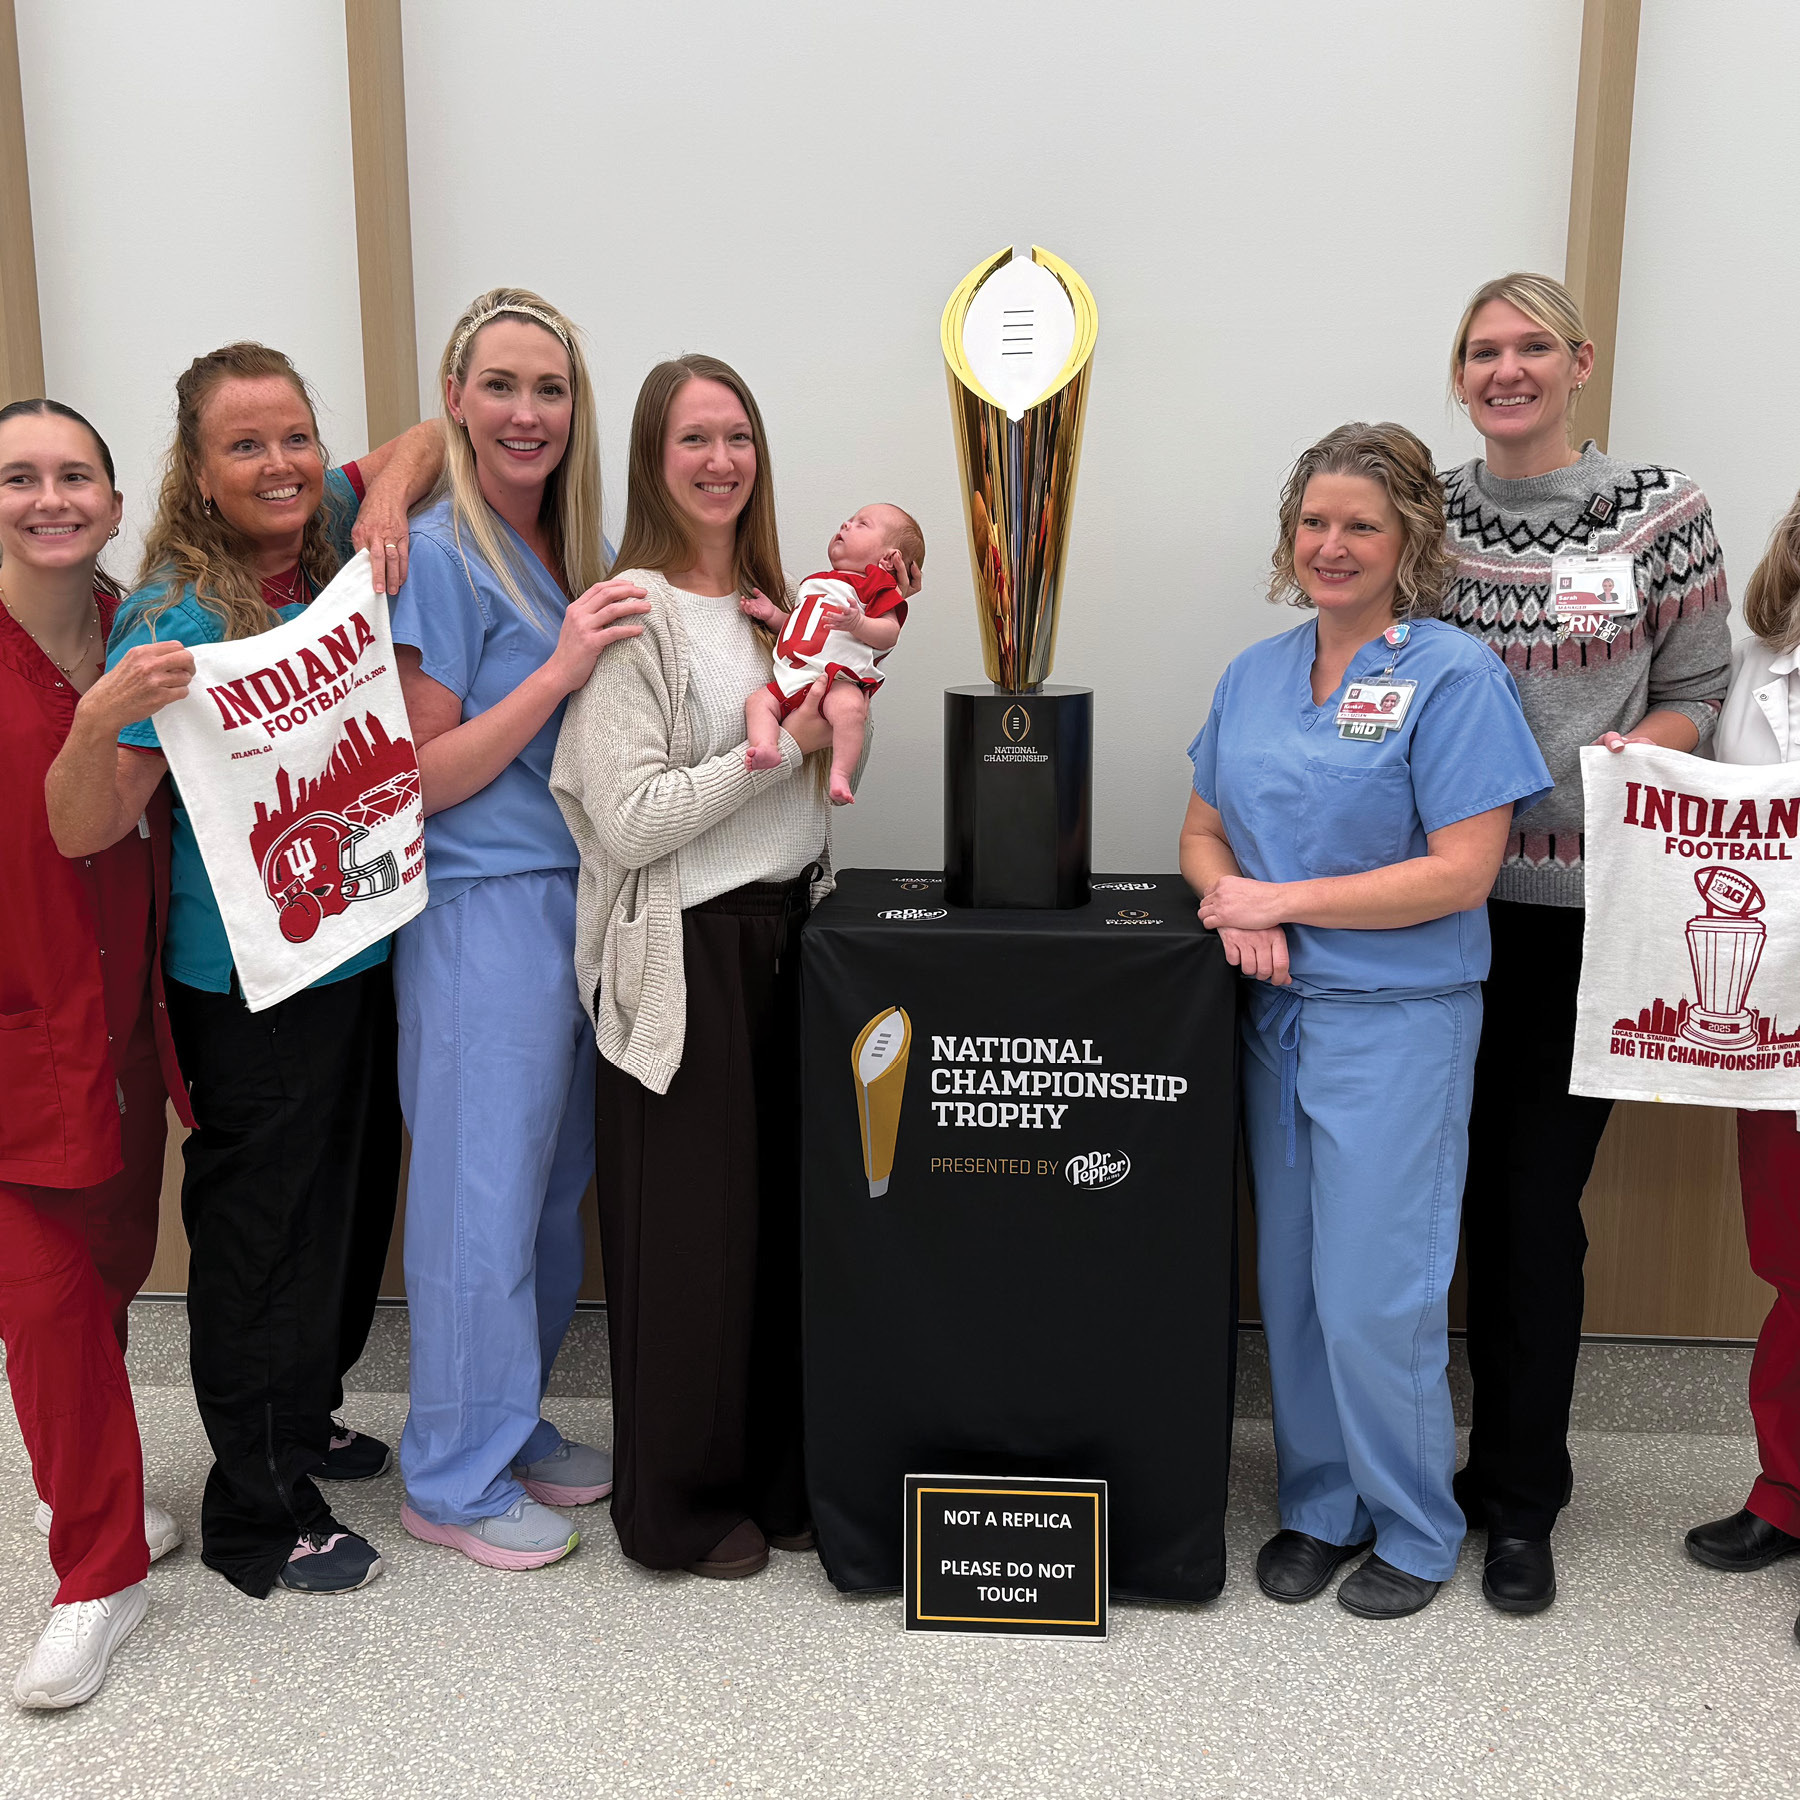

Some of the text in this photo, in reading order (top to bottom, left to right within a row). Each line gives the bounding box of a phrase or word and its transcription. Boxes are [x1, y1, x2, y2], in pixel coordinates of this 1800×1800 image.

[1569, 614, 1604, 632] RN
[206, 611, 376, 731] INDIANA
[371, 665, 387, 678] 2026
[1350, 722, 1377, 735] MD
[263, 744, 273, 753] GA
[994, 746, 1038, 754] NATIONAL
[983, 754, 1049, 762] CHAMPIONSHIP
[1665, 836, 1793, 861] FOOTBALL
[1612, 1029, 1676, 1043] LUCAS OIL STADIUM
[1708, 1022, 1731, 1033] 2025
[931, 1035, 1103, 1066] NATIONAL
[1610, 1037, 1636, 1058] BIG
[1638, 1040, 1665, 1061] TEN
[1667, 1044, 1781, 1071] CHAMPIONSHIP
[931, 1068, 1188, 1102] CHAMPIONSHIP
[931, 1101, 1069, 1130] TROPHY
[931, 1157, 1059, 1175] PRESENTED BY
[1088, 1151, 1111, 1169] Dr
[1067, 1156, 1126, 1185] Pepper
[944, 1510, 1072, 1529] NOT A REPLICA
[941, 1560, 1075, 1579] PLEASE DO NOT
[977, 1586, 1038, 1603] TOUCH
